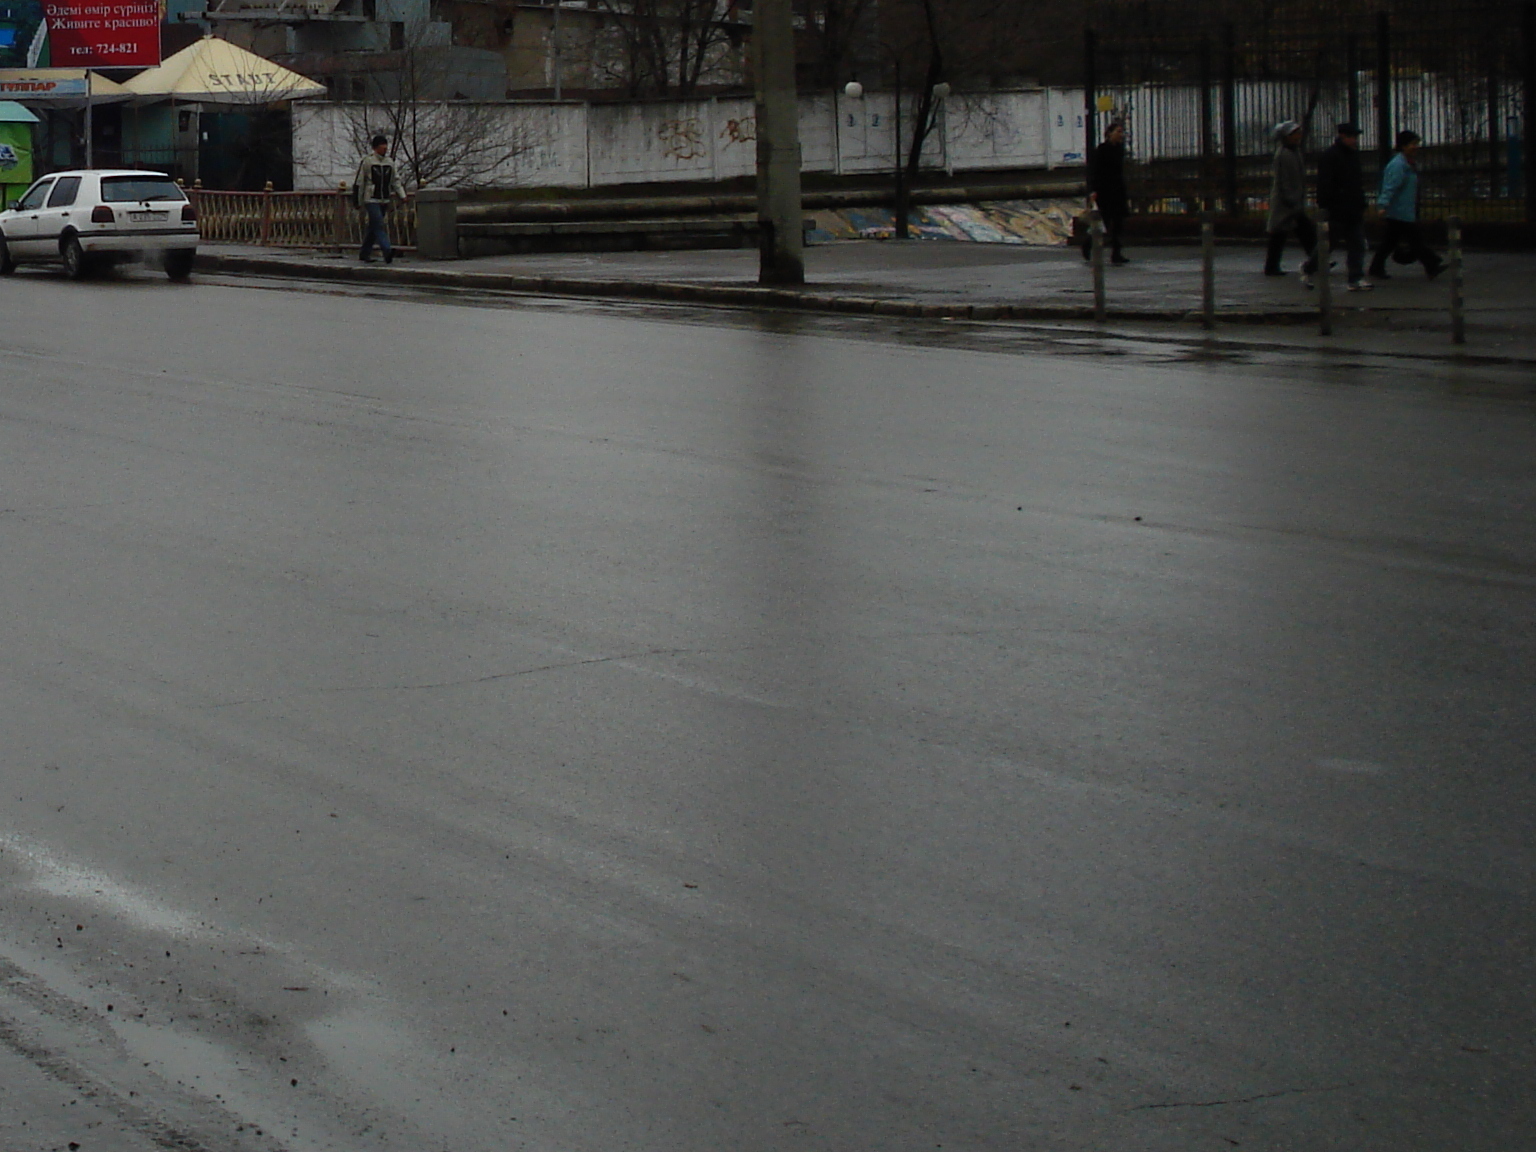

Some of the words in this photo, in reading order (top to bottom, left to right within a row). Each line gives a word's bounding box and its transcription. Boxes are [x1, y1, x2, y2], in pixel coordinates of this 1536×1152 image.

[46, 3, 82, 17] Әдемі
[84, 3, 111, 17] өмір
[51, 17, 101, 29] Живите
[104, 15, 158, 30] красиво!
[70, 46, 93, 55] тел:
[96, 43, 138, 54] 724-821
